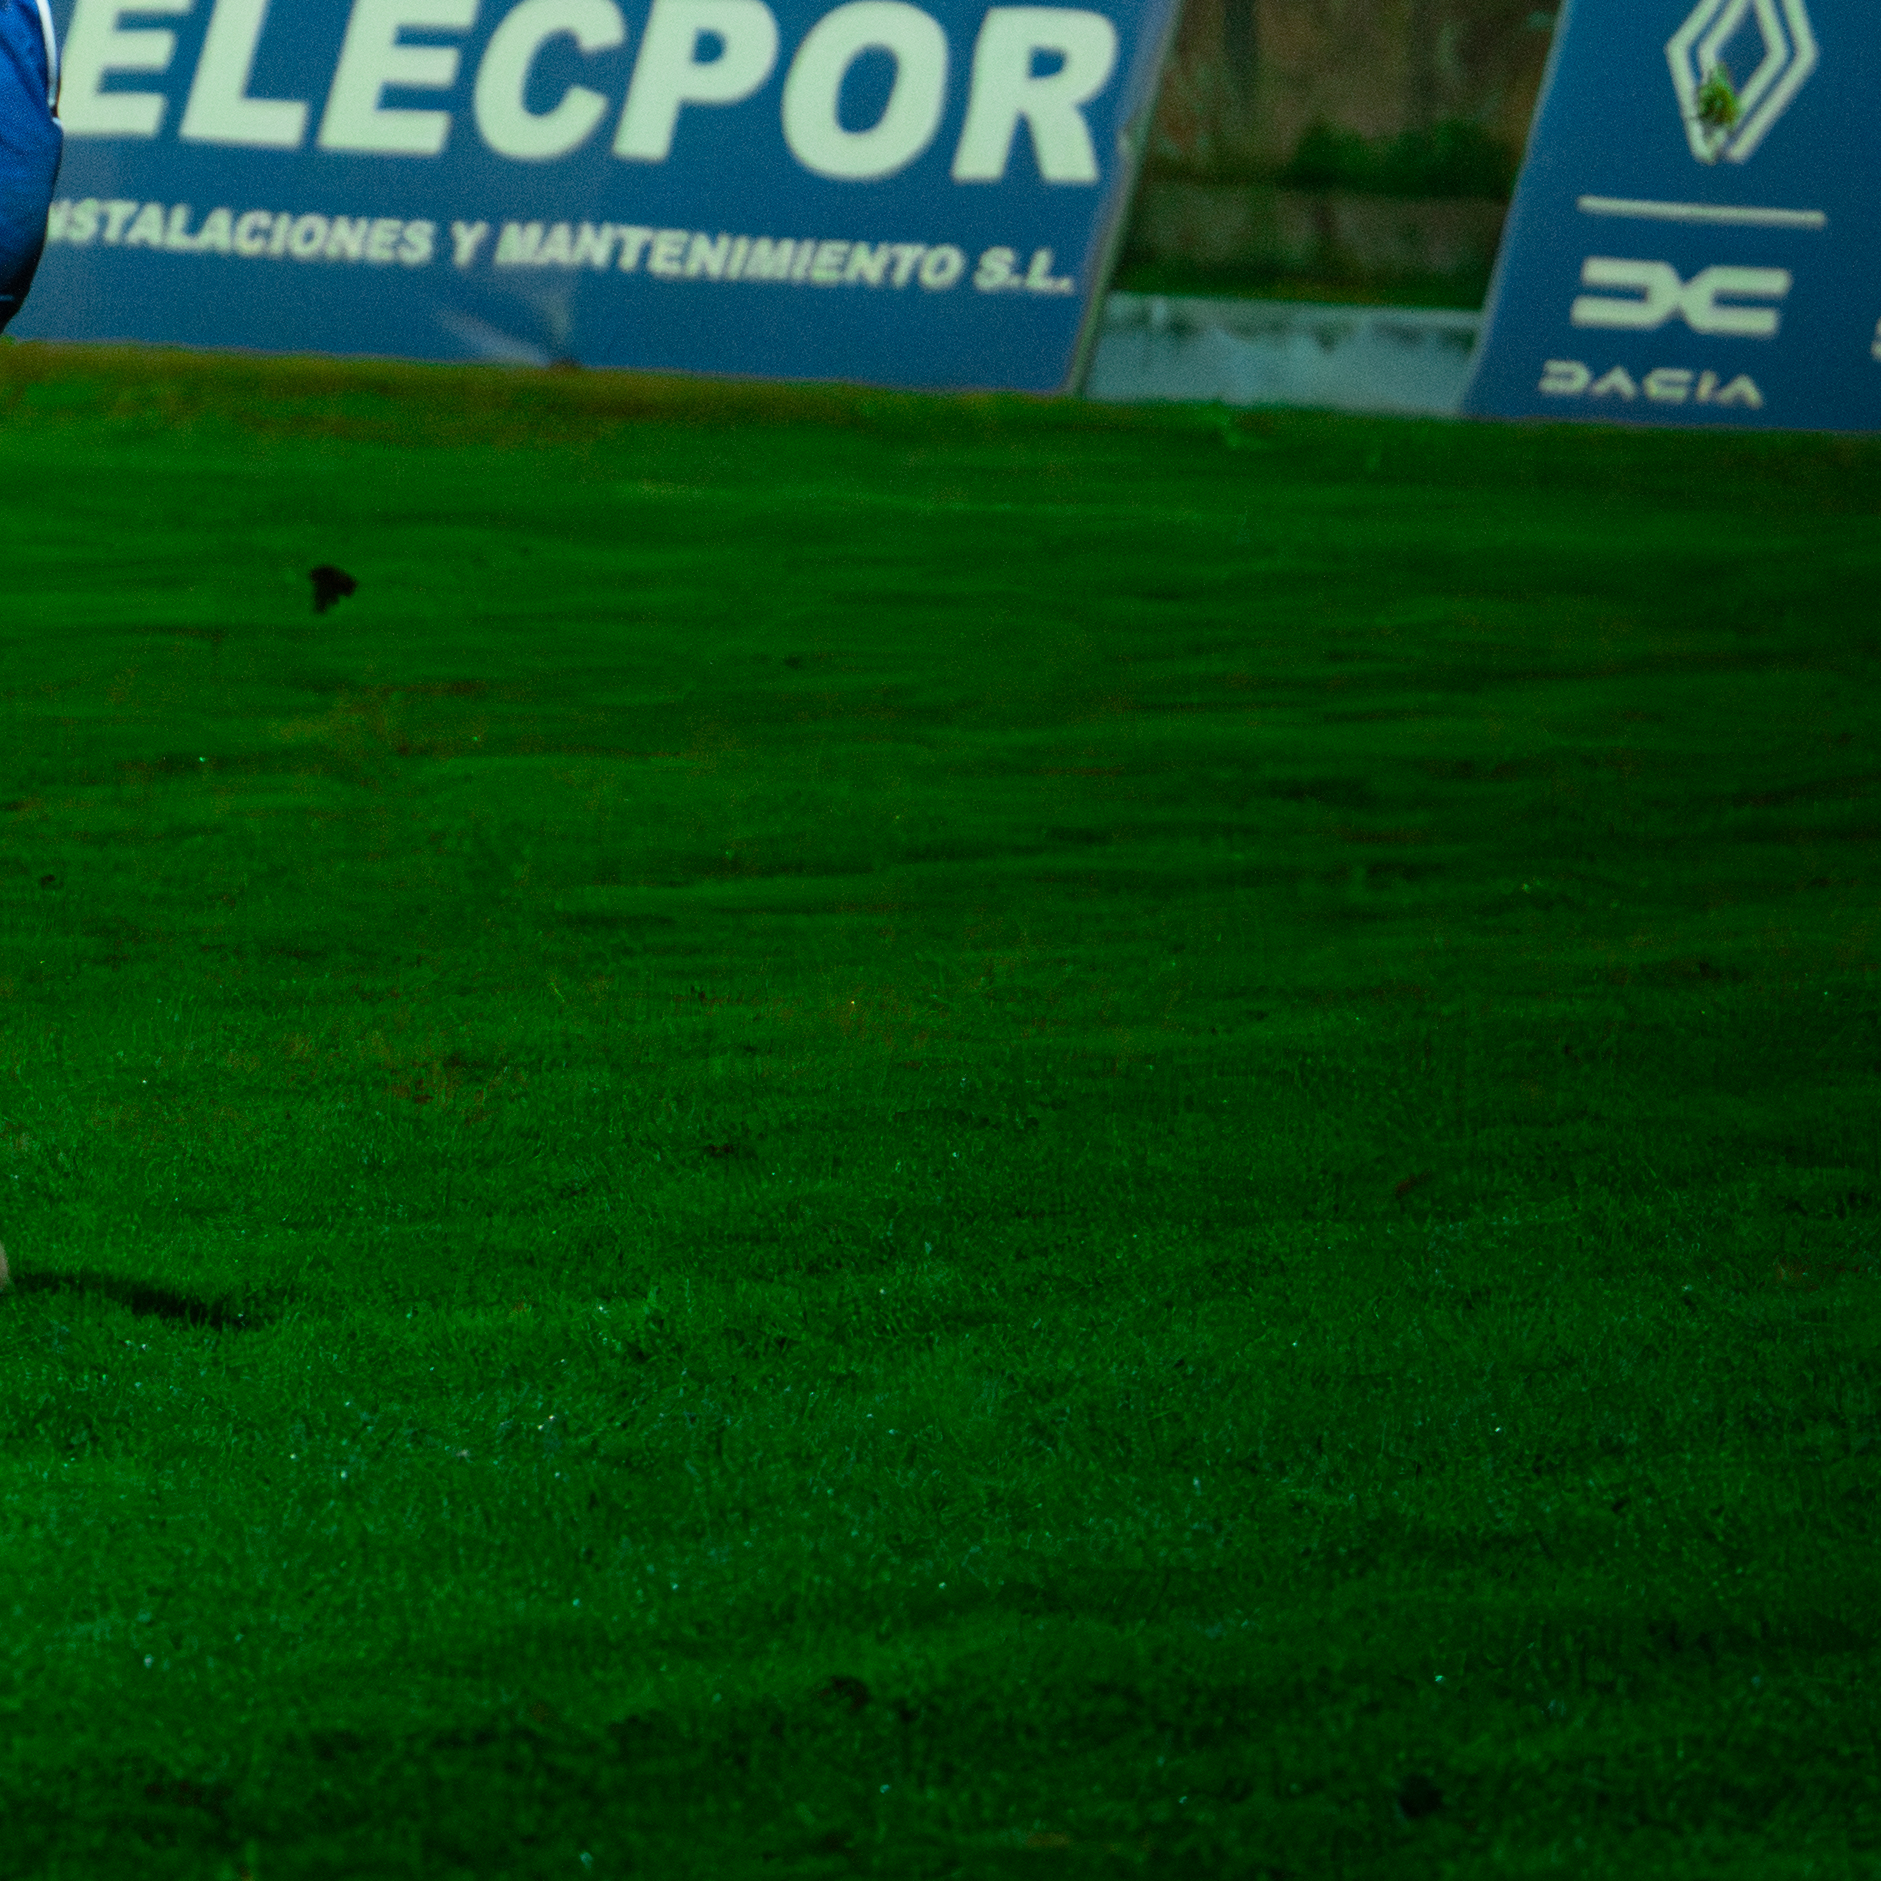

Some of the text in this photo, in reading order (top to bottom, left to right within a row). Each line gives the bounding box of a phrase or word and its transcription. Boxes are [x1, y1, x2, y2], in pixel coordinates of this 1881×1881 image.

[449, 220, 489, 269] Y
[493, 220, 967, 293] MANTENIMIENTO
[973, 243, 1075, 297] S.L.
[1539, 358, 1765, 411] DACIA
